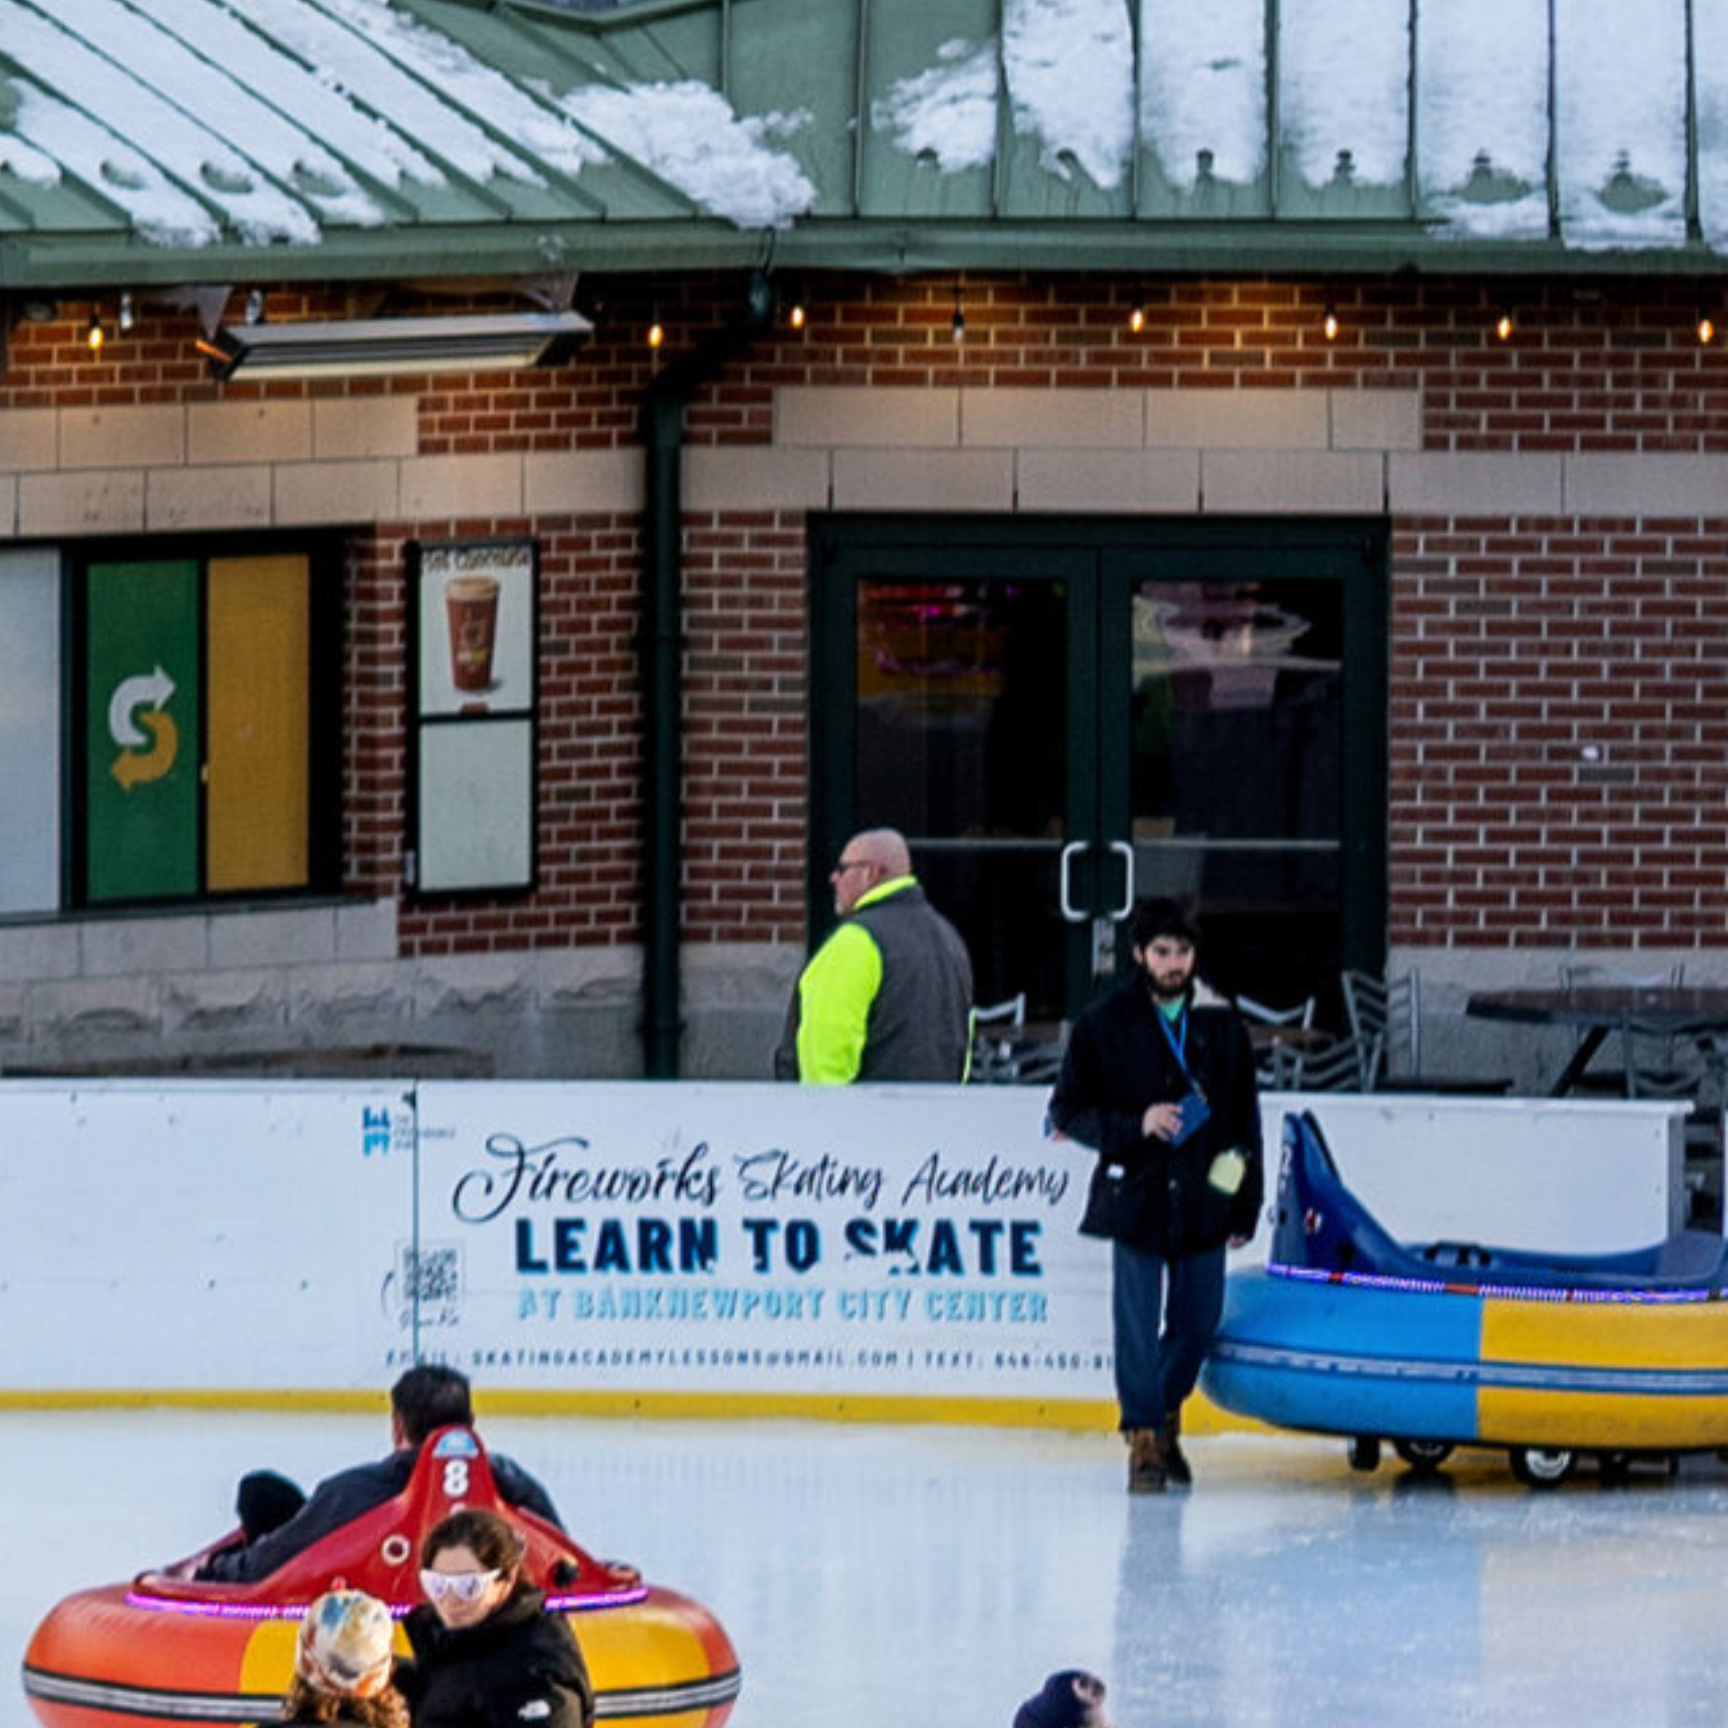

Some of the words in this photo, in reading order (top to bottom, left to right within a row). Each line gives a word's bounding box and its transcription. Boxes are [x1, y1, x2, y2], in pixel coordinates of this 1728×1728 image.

[452, 1133, 721, 1224] Fireworks
[733, 1149, 884, 1208] Skating
[901, 1151, 1071, 1208] Academy
[515, 1216, 718, 1275] LEARN
[742, 1217, 822, 1275] TO
[844, 1217, 1045, 1277] SKATE
[518, 1287, 562, 1321] AT
[573, 1288, 825, 1322] BANKNEWPORT
[837, 1289, 917, 1322] CITY
[925, 1289, 1049, 1325] CENTER
[442, 1459, 470, 1499] 8
